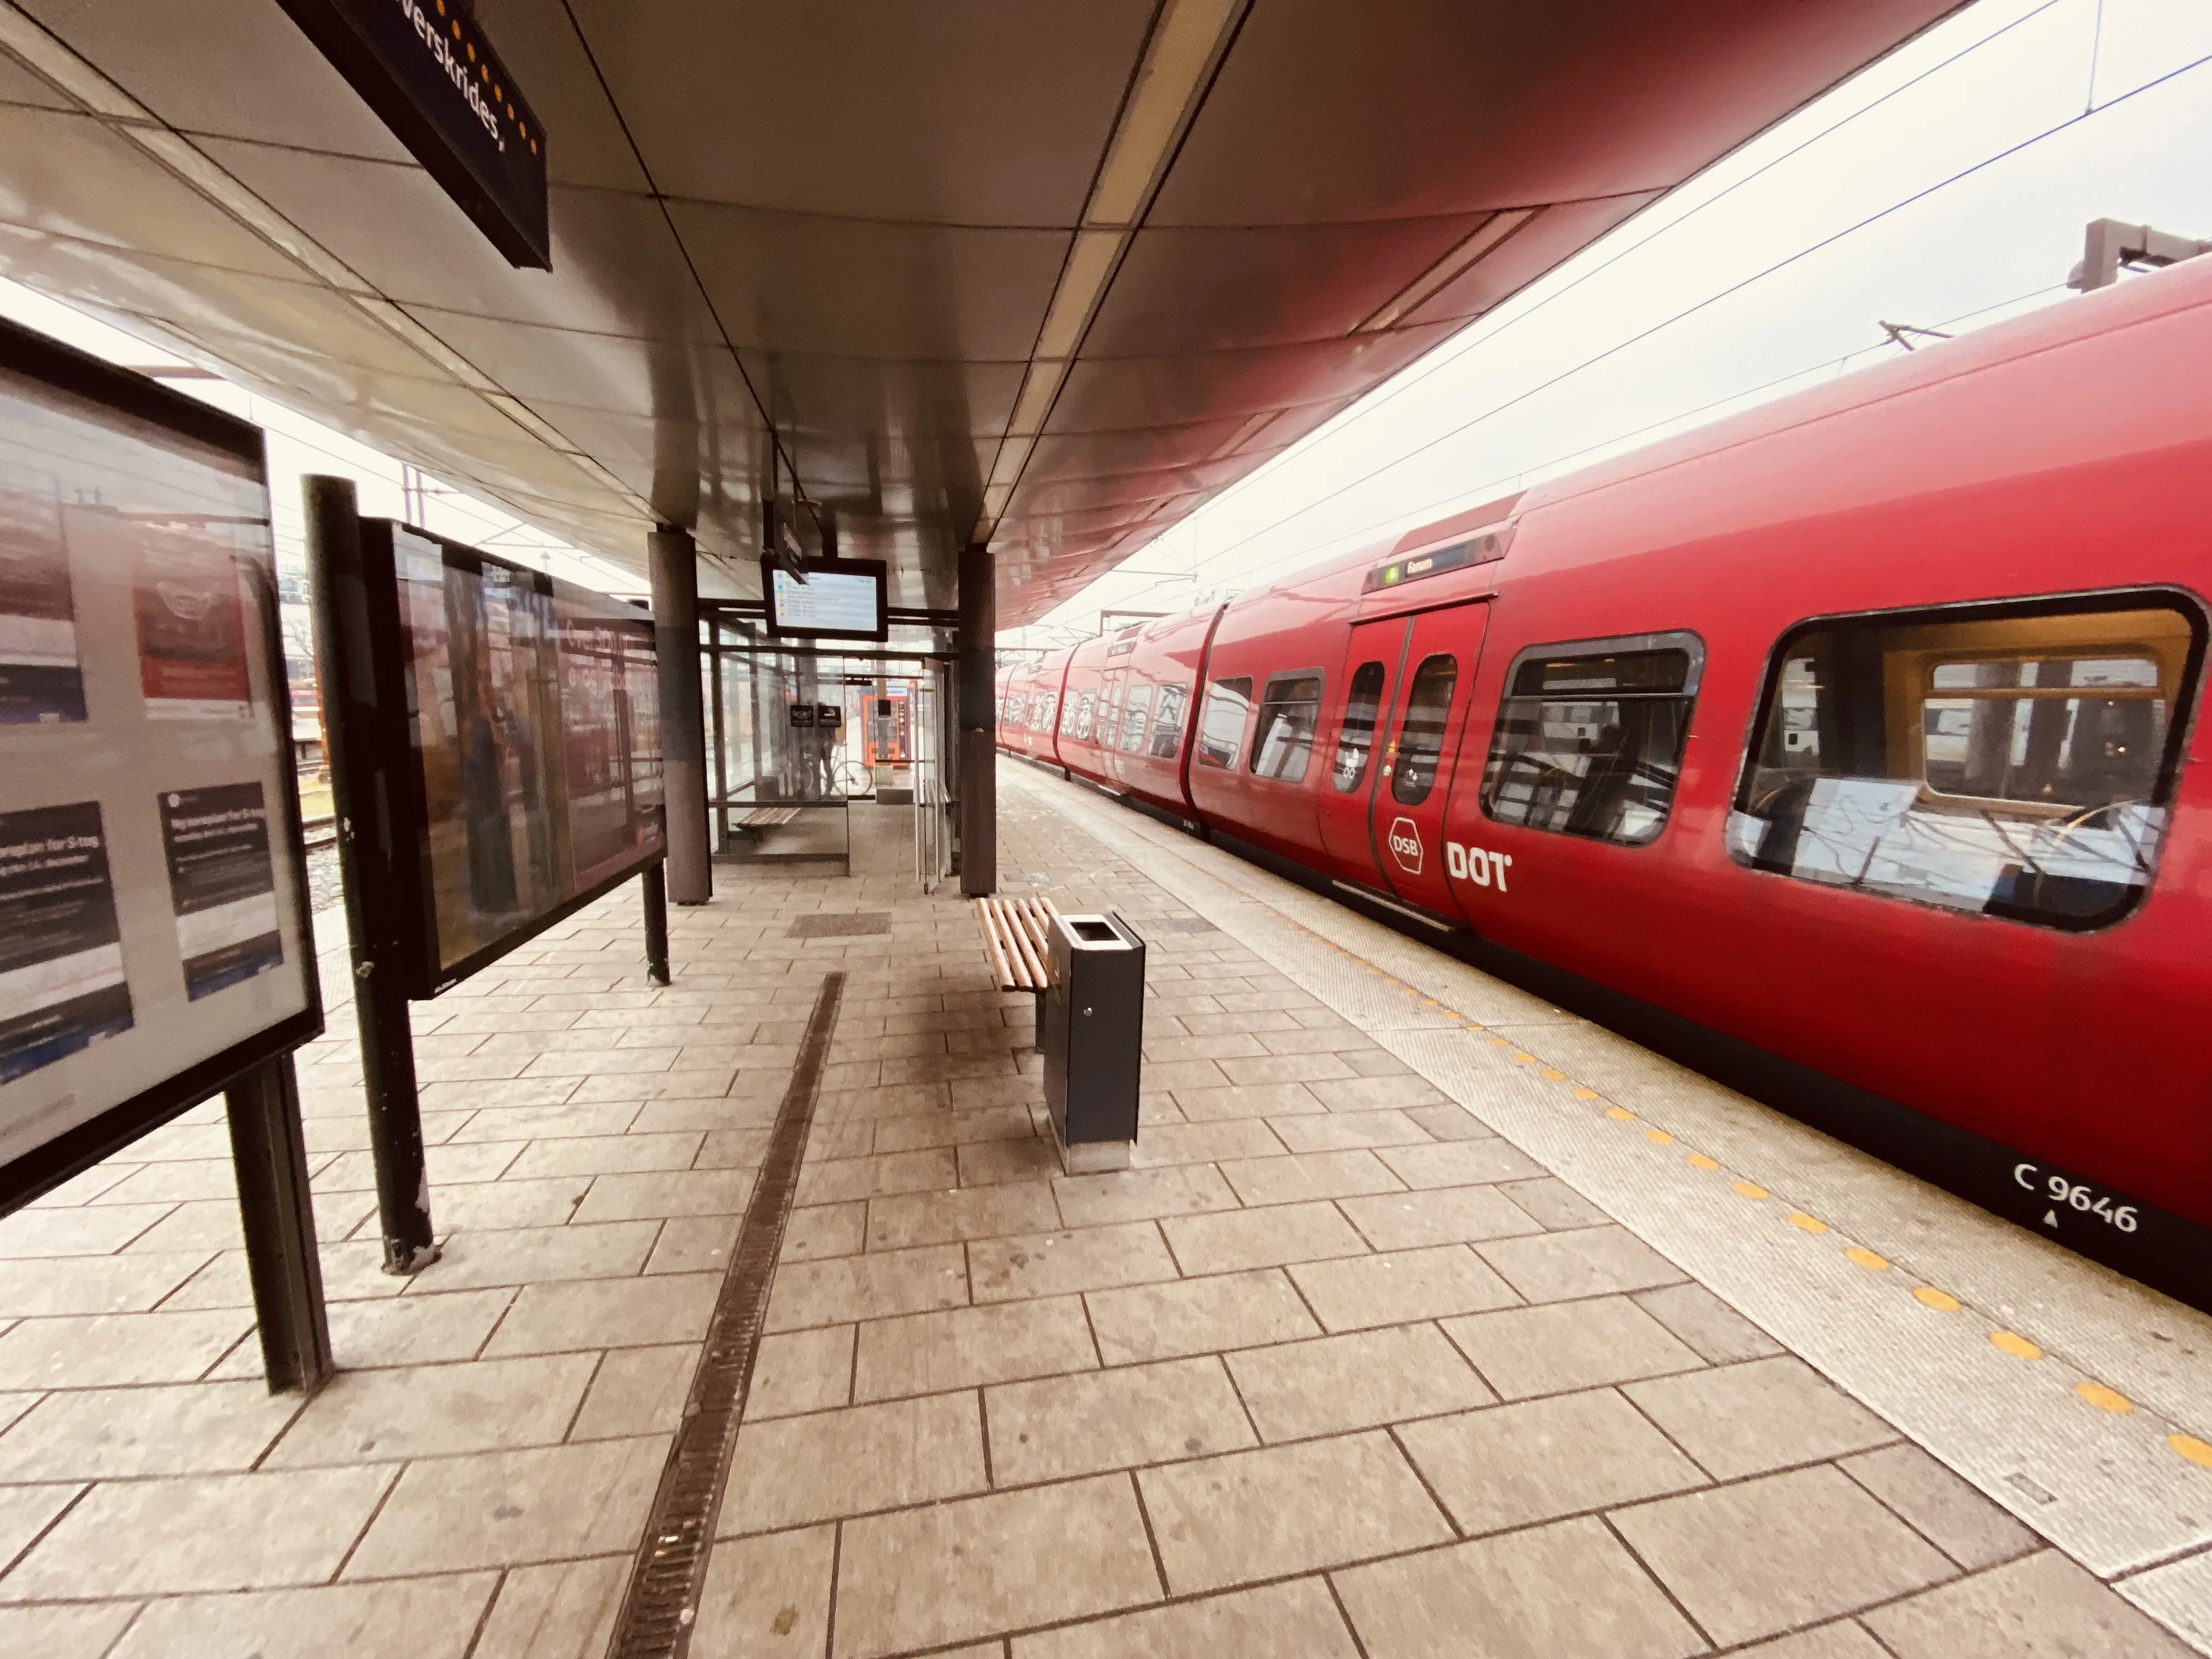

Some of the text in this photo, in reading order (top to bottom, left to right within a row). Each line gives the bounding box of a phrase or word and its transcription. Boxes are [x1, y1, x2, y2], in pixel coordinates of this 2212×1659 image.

[395, 0, 505, 153] verskrides,
[1393, 835, 1419, 856] DSB
[1447, 841, 1513, 893] DOT
[2014, 1164, 2138, 1233] C 9646
